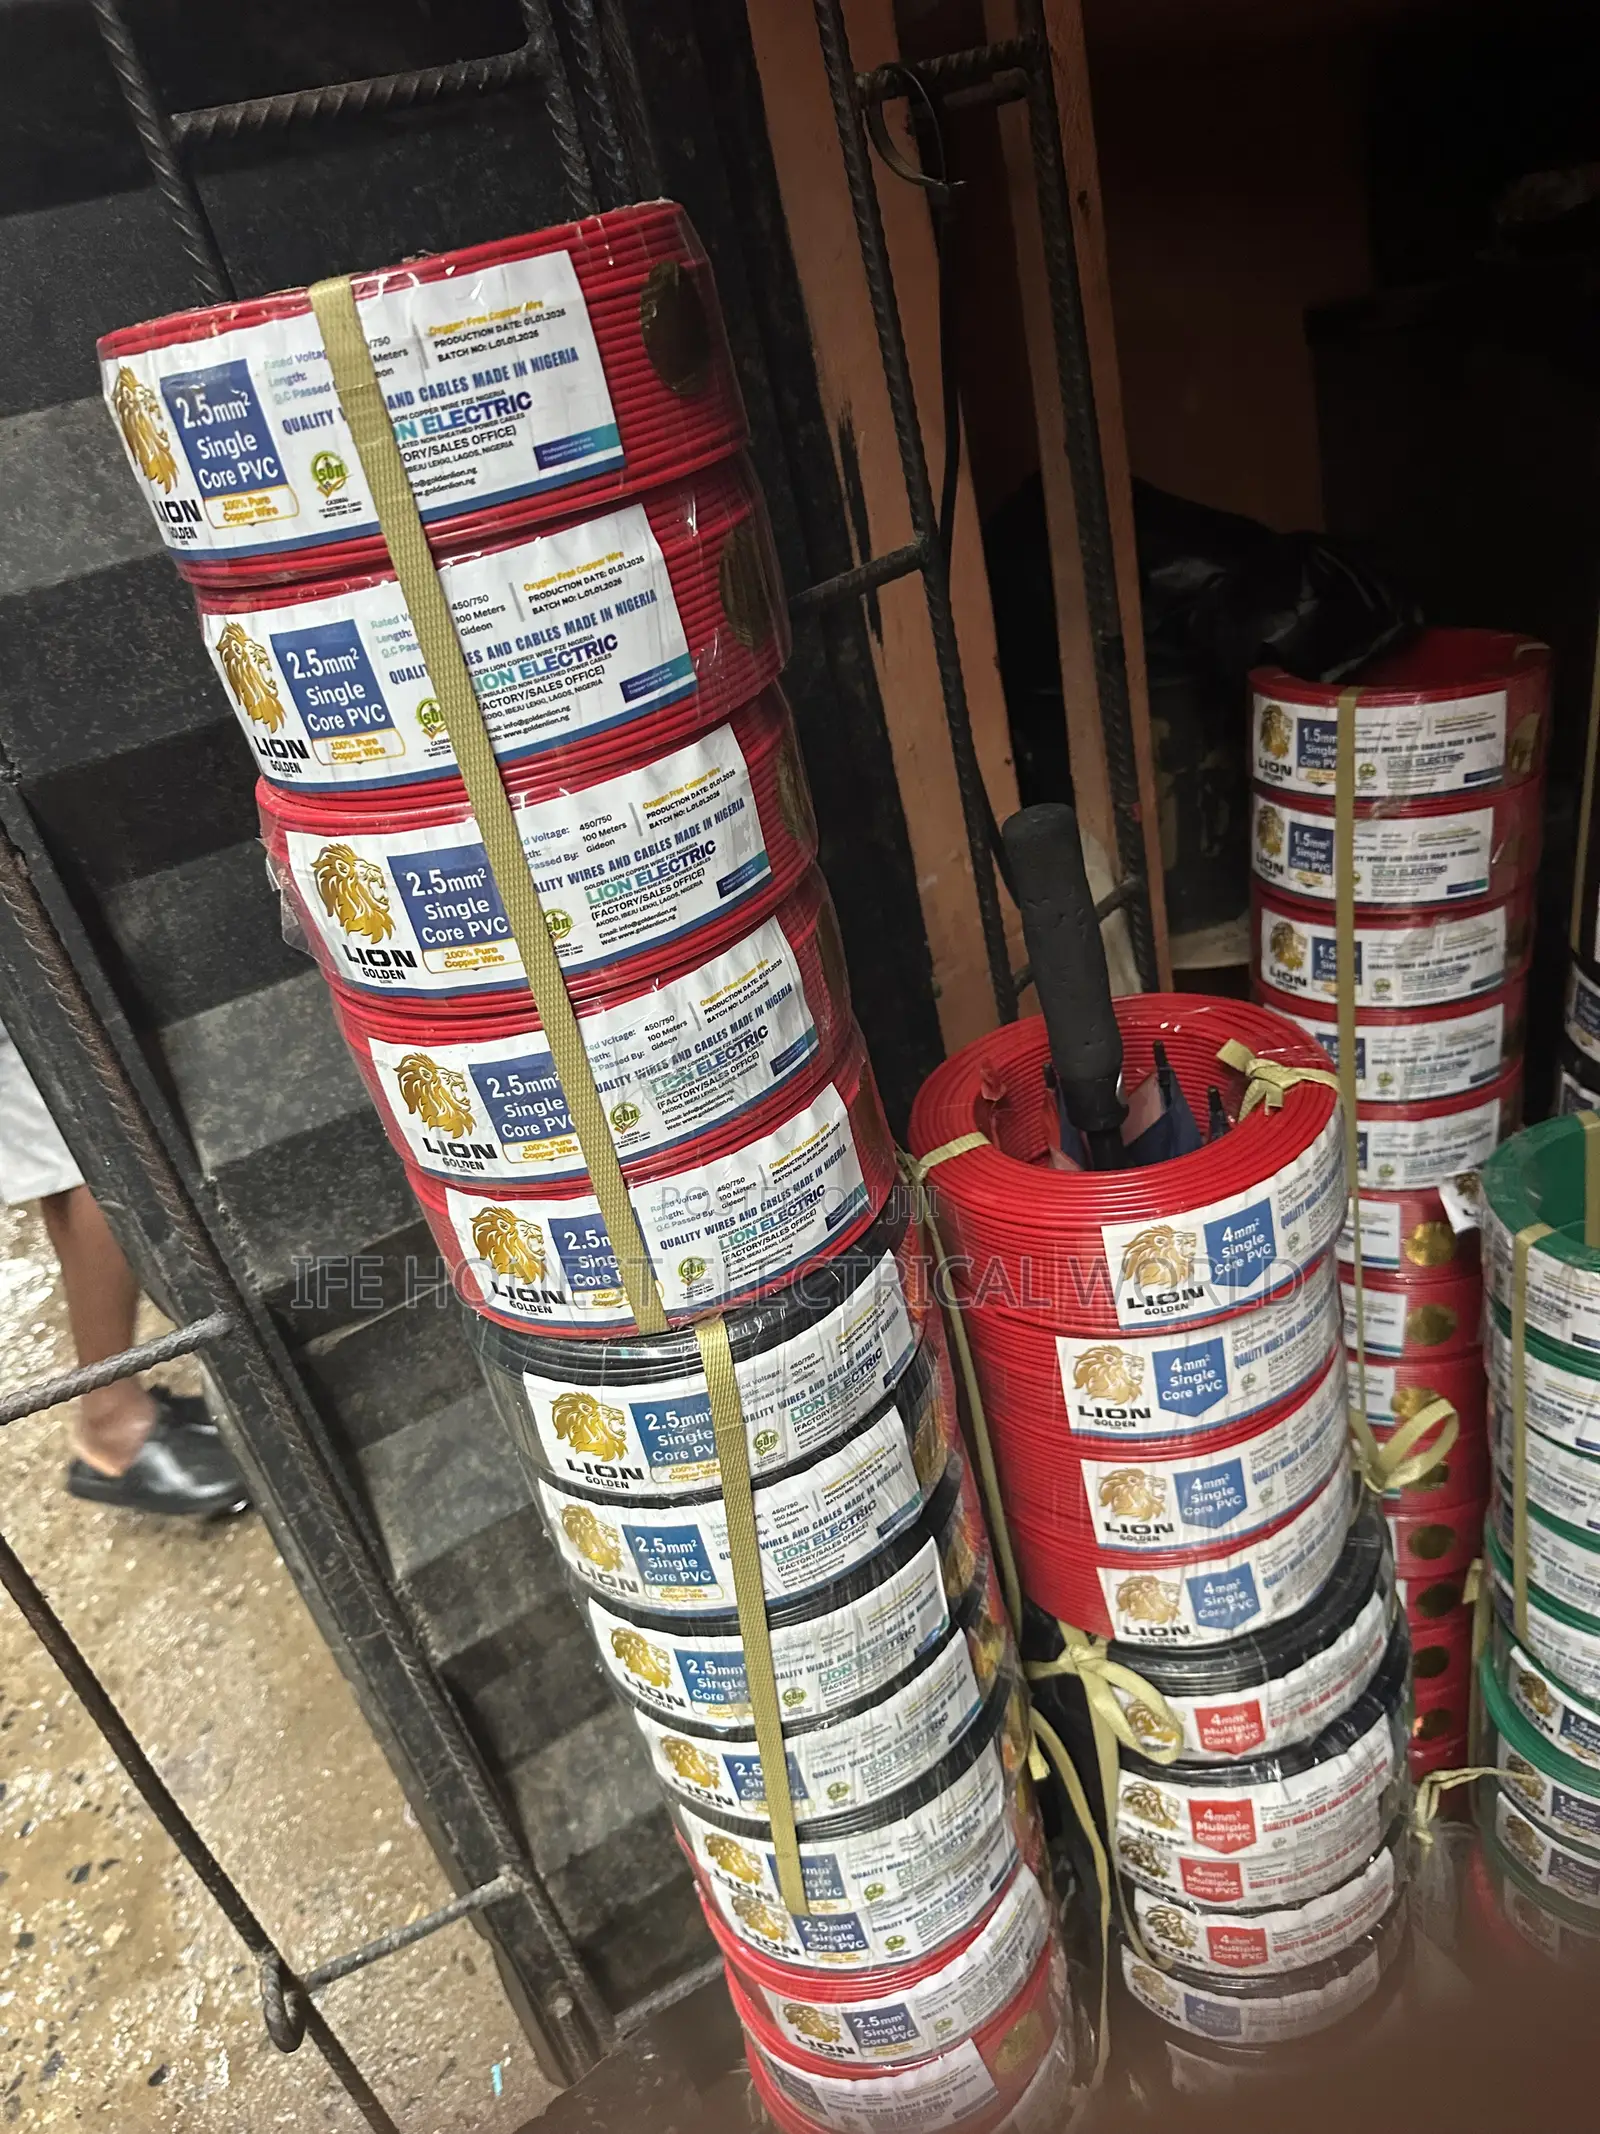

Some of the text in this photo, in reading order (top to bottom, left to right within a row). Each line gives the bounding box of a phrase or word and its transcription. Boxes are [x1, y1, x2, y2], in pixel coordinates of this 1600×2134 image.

[434, 326, 494, 349] PRODUCTION
[387, 347, 579, 410] AND CABLES MADE IN NIGERIA
[283, 410, 334, 435] QUALITY
[421, 391, 532, 435] ELECTRIC
[197, 431, 258, 459] Single
[472, 424, 516, 445] OFFICE)
[199, 457, 279, 489] Core PVC
[153, 499, 203, 523] LION
[528, 580, 582, 603] PRODUCTION
[584, 571, 607, 583] DATE:
[532, 601, 560, 615] BATCH
[461, 621, 493, 637] Gideon
[486, 589, 657, 660] AND CABLES MADE IN NIGERIA
[518, 634, 618, 680] ELECTRIC
[306, 681, 365, 707] Single
[307, 704, 385, 732] Core PVC
[253, 736, 310, 760] LION
[271, 761, 302, 774] GOLDEN
[1258, 758, 1292, 776] LION
[647, 795, 690, 819] PRODUCTION
[583, 822, 627, 843] 100 Meters
[649, 815, 673, 829] BATCH
[531, 827, 570, 844] Voltage:
[568, 797, 745, 885] WIRES AND CABLES MADE IN NIGERIA
[587, 838, 615, 853] Gideon
[586, 840, 716, 905] LION ELECTRIC
[1256, 852, 1284, 874] LION
[591, 868, 705, 921] (FACTORY/SALES OFFICE)
[424, 896, 490, 921] Single
[422, 916, 509, 945] Core PVC
[341, 943, 418, 969] LION
[362, 967, 406, 980] GOLDEN
[1269, 965, 1307, 988] LION
[694, 1017, 754, 1055] CABLES MADE
[696, 1025, 769, 1075] ELECTRIC
[504, 1096, 565, 1119] Single
[502, 1121, 540, 1139] Core
[422, 1138, 498, 1159] LION
[443, 1157, 485, 1171] GOLDEN
[660, 1190, 792, 1250] QUALITY WIRES AND CABLES
[719, 1185, 826, 1250] LION ELECTRIC
[1220, 1232, 1266, 1258] Single
[1214, 1243, 1272, 1276] Core PVC
[573, 1273, 611, 1287] Core
[492, 1281, 567, 1305] LION
[1127, 1286, 1205, 1309] LION
[510, 1300, 552, 1314] GOLDEN
[1144, 1302, 1189, 1316] GOLDEN
[790, 1347, 883, 1422] LION ELECTRIC
[1170, 1368, 1216, 1388] Single
[1162, 1379, 1223, 1402] Core PVC
[1078, 1404, 1151, 1419] LION
[1094, 1419, 1136, 1428] GOLDEN
[657, 1429, 713, 1447] Single
[653, 1447, 689, 1463] Core
[566, 1458, 645, 1480] LION
[586, 1476, 629, 1489] GOLDEN
[1184, 1495, 1242, 1517] Core PVC
[1190, 1486, 1236, 1504] Single
[759, 1525, 810, 1551] WIRES AND
[773, 1500, 877, 1563] LION ELECTRIC
[1104, 1521, 1175, 1534] LION
[648, 1557, 698, 1571] Single
[576, 1560, 640, 1594] LION
[644, 1571, 712, 1583] Core PVC
[1204, 1590, 1248, 1607] Single
[1124, 1624, 1191, 1637] LION
[624, 1673, 687, 1708] LION
[692, 1689, 724, 1701] Core
[739, 1925, 800, 1957] LION
[811, 1931, 856, 1945] Single
[840, 1937, 866, 1950] PVC
[860, 2029, 917, 2047] Core PVC
[863, 2023, 907, 2039] Single
[795, 2034, 856, 2057] LION
